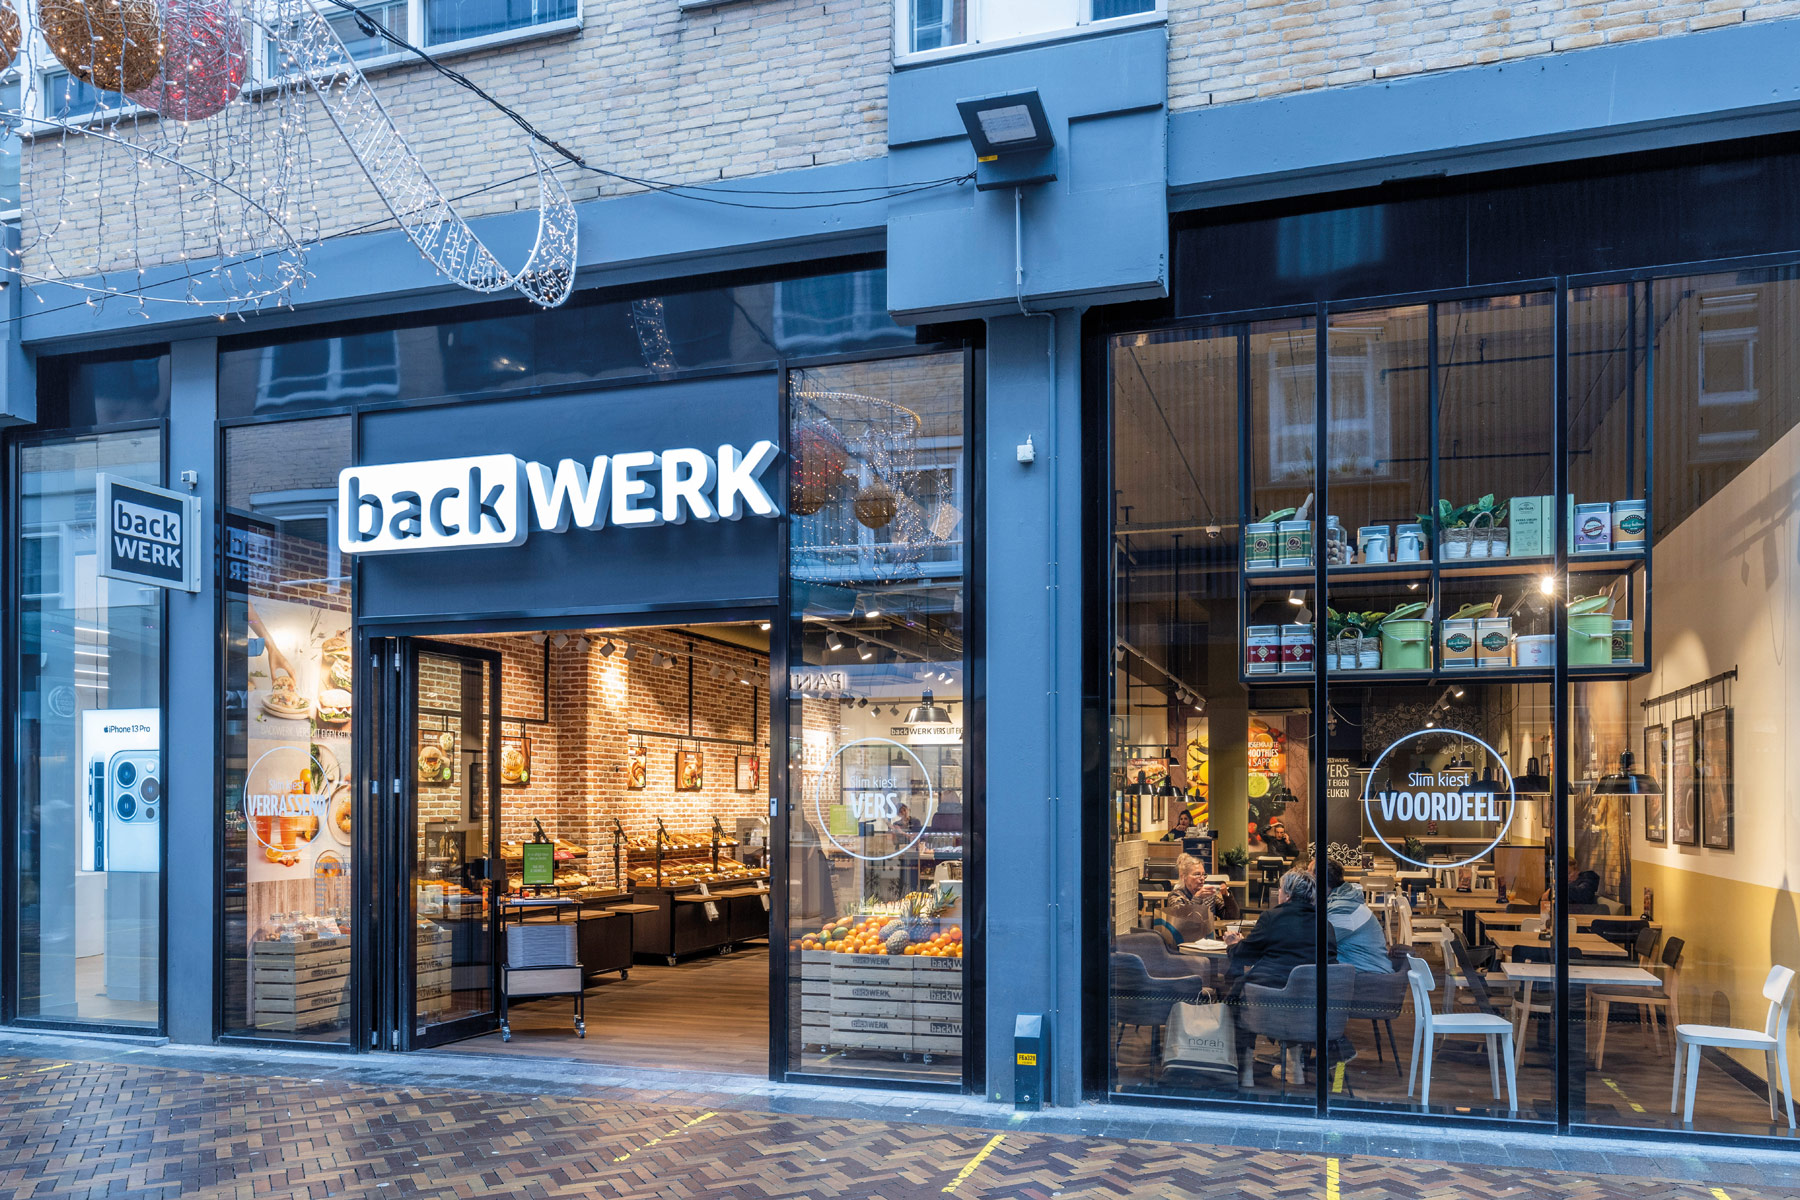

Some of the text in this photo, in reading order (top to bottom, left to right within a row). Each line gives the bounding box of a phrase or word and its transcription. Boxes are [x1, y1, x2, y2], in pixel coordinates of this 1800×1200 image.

[118, 503, 177, 541] back
[114, 535, 181, 569] WERK
[109, 724, 151, 733] iPhone 13 Pro
[1248, 749, 1278, 757] MOOTHIES
[1253, 758, 1279, 767] SAPPEN
[269, 778, 304, 791] Slim kiest
[850, 776, 896, 788] Slim kiest
[1408, 772, 1470, 786] Slim kiest
[1327, 789, 1349, 797] EUKEN
[248, 794, 326, 817] VERRASSEND
[851, 792, 898, 818] VERS
[1380, 792, 1500, 821] VOORDEEL
[1188, 1038, 1224, 1048] norah
